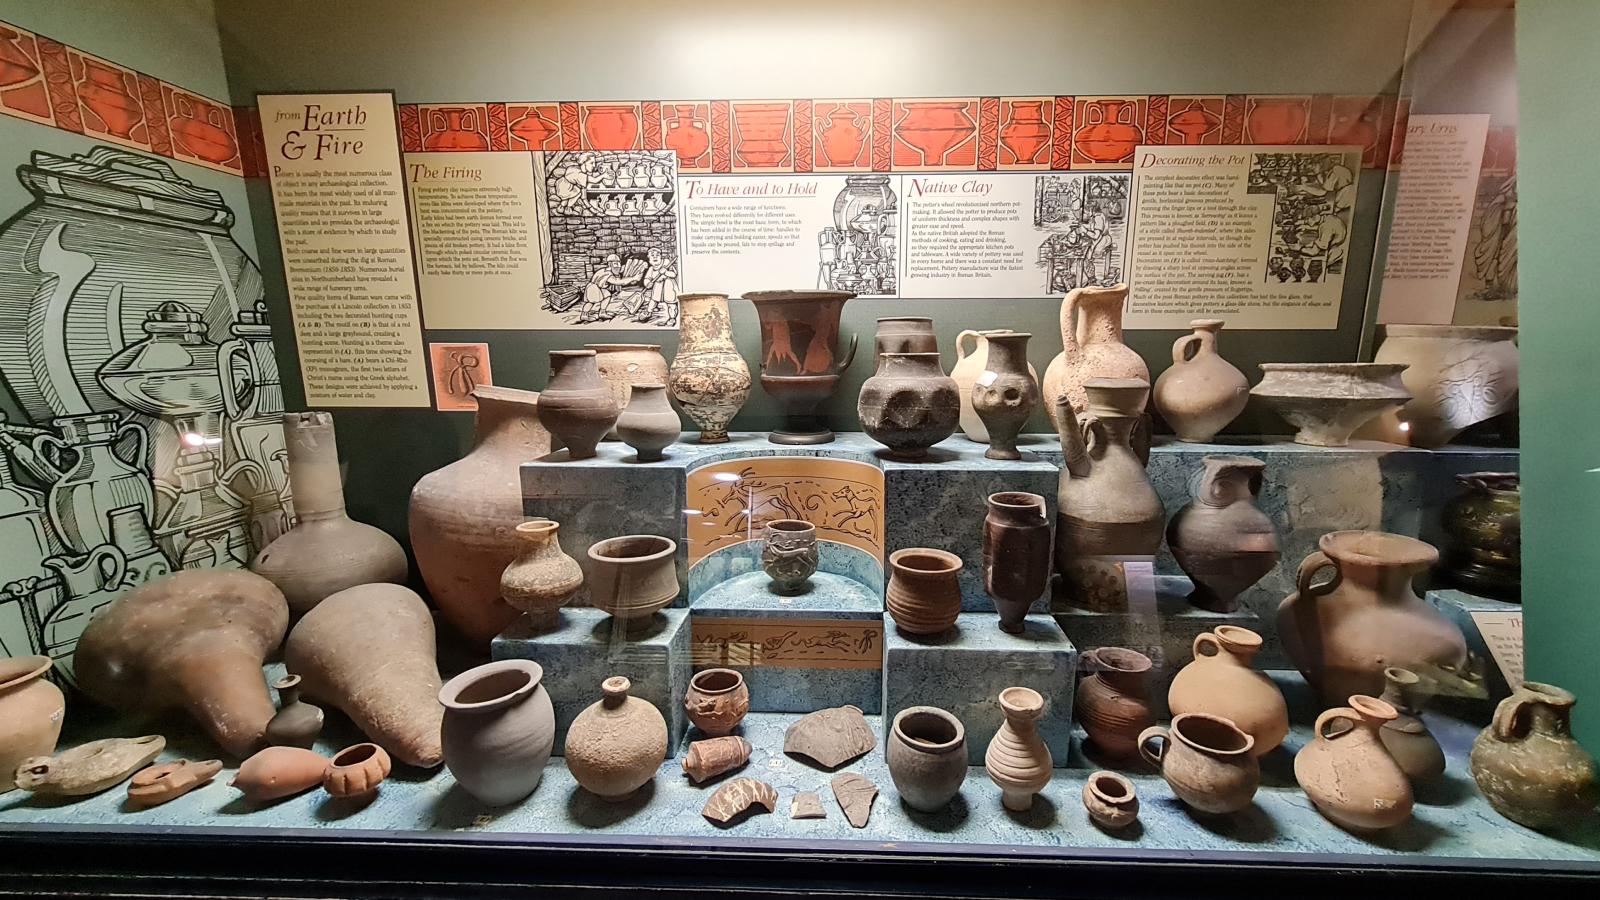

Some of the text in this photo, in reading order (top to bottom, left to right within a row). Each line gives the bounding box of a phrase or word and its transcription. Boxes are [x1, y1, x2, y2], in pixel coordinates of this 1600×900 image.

[275, 105, 366, 131] from Earth
[282, 131, 363, 160] & Fire
[1141, 154, 1245, 168] Decorating the Pot
[410, 164, 482, 182] The Firing
[686, 181, 818, 199] To Have and to Hold
[908, 179, 992, 197] Native Clay
